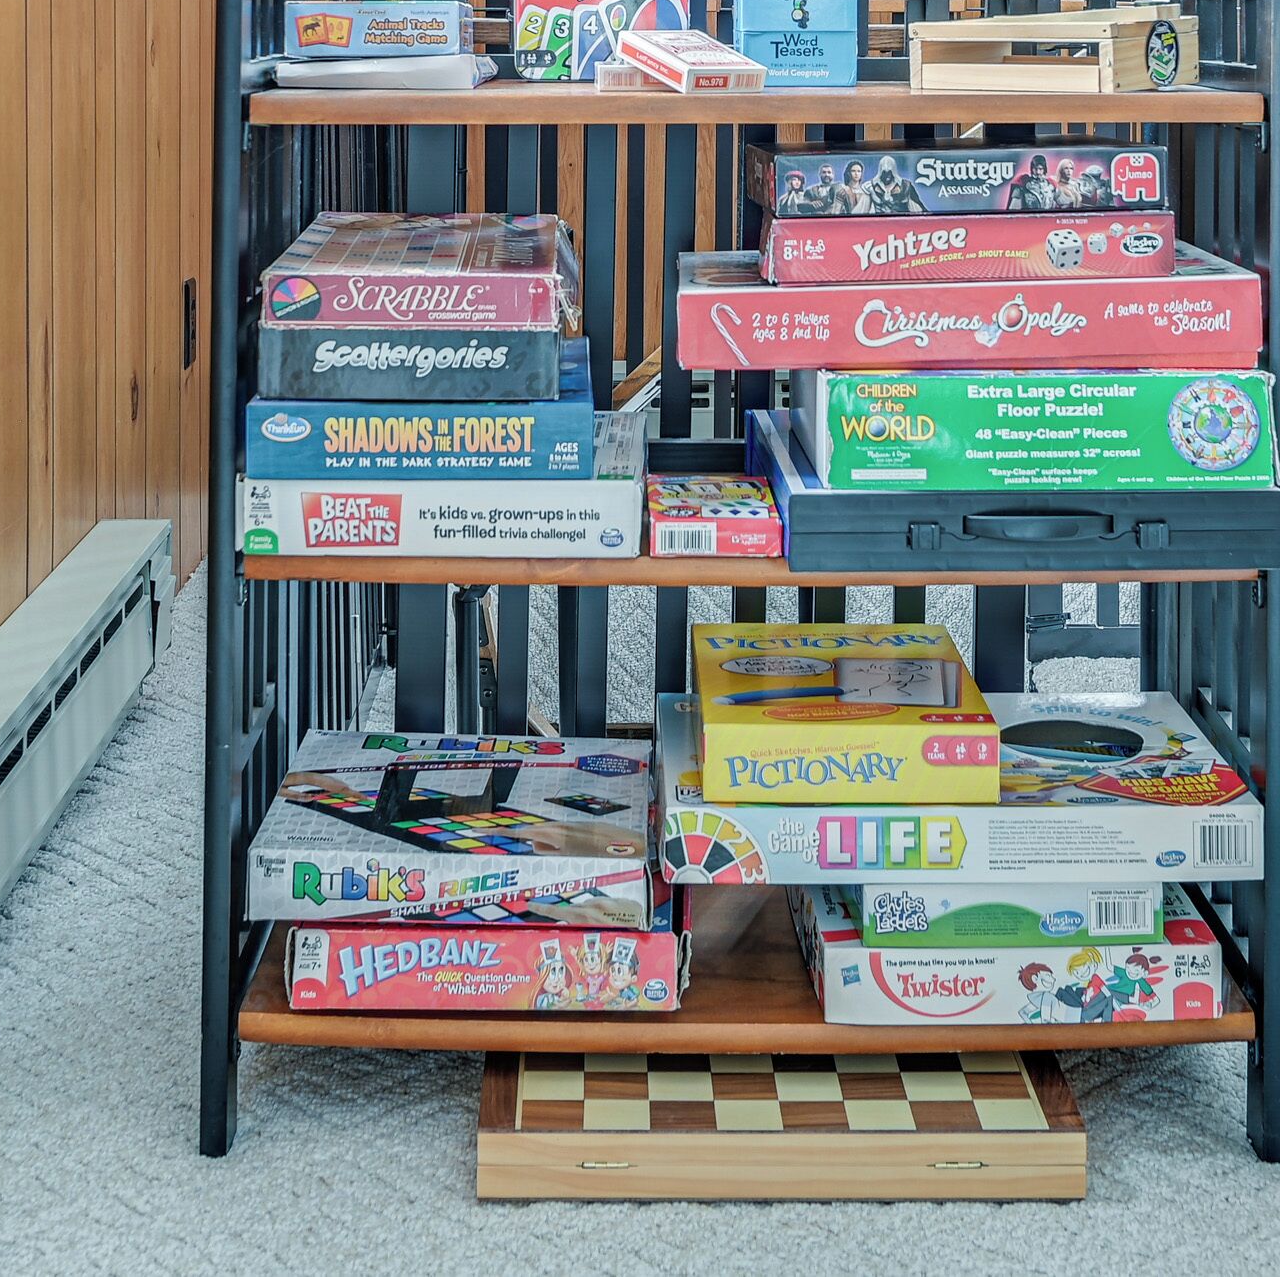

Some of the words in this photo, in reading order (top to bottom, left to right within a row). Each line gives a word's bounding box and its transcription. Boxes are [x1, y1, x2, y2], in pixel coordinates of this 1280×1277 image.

[369, 17, 408, 31] Animal
[410, 18, 446, 31] Tracks
[525, 16, 542, 35] 2
[554, 18, 570, 38] 3
[583, 14, 599, 35] 4
[364, 30, 415, 47] Matching
[416, 33, 448, 45] Game
[783, 33, 818, 46] Word
[770, 41, 824, 58] Teasers
[768, 68, 789, 77] World
[790, 69, 830, 78] Geography
[916, 158, 1014, 186] Stratego
[1118, 165, 1153, 182] Jumbo
[783, 247, 799, 260] 8+
[852, 226, 968, 271] Yahtzee
[910, 256, 938, 267] SHAKE,
[939, 252, 964, 263] SCORE,
[978, 250, 1005, 259] SHOUT
[1005, 249, 1030, 258] GAME!
[333, 277, 483, 320] SCRABBLE
[428, 310, 472, 319] crossword
[472, 312, 496, 321] game
[1104, 302, 1115, 319] A
[1118, 305, 1144, 316] game
[1148, 301, 1159, 315] to
[1163, 298, 1213, 314] celebrate
[752, 314, 761, 326] 2
[765, 312, 778, 325] to
[782, 314, 789, 325] 6
[794, 311, 830, 326] Players
[854, 298, 984, 348] Christmas
[1154, 315, 1168, 327] the
[1171, 310, 1231, 335] Season!
[752, 328, 775, 343] Ages
[780, 328, 788, 340] 8
[792, 327, 811, 339] And
[816, 327, 830, 341] Up
[313, 339, 508, 377] Scattergories
[856, 383, 917, 398] CHILDREN
[967, 385, 1013, 399] Extra
[1017, 385, 1065, 403] Large
[1070, 384, 1137, 398] Circular
[870, 400, 882, 412] of
[885, 400, 904, 412] the
[997, 403, 1041, 417] Floor
[1045, 403, 1103, 417] Puzzle!
[324, 416, 432, 453] SHADOWS
[437, 418, 448, 434] IN
[453, 416, 535, 453] FOREST
[840, 415, 935, 442] WORLD
[975, 429, 992, 440] 48
[1083, 428, 1128, 439] Pieces
[434, 435, 452, 452] THE
[555, 442, 579, 453] AGES
[325, 457, 355, 468] PLAY
[359, 457, 371, 467] IN
[375, 457, 398, 467] THE
[402, 457, 432, 467] DARK
[437, 456, 494, 467] STRATEGY
[499, 457, 532, 467] GAME
[562, 454, 579, 462] Adult
[965, 449, 994, 459] Giant
[995, 450, 1028, 460] puzzle
[1030, 450, 1081, 458] measures
[1102, 448, 1141, 458] across!
[1031, 476, 1061, 485] looking
[321, 494, 371, 521] BEAT
[368, 505, 390, 519] THE
[439, 505, 468, 520] kids
[471, 512, 486, 520] vs.
[489, 508, 563, 523] grown-ups
[566, 509, 577, 520] in
[578, 509, 600, 520] this
[308, 517, 397, 545] PARENTS
[433, 525, 496, 538] fun-filled
[499, 527, 528, 538] trivia
[530, 527, 586, 542] challenge!
[704, 634, 943, 651] PICTIONARY
[1031, 704, 1082, 715] Spin
[1089, 708, 1112, 717] to
[750, 749, 772, 758] Quick
[774, 747, 813, 756] Sketches,
[724, 752, 903, 789] PICTIONARY
[1118, 778, 1165, 787] KIDS
[1169, 774, 1221, 785] HAVE
[1132, 782, 1219, 794] SPOKEN!
[780, 817, 804, 835] the
[768, 829, 820, 854] Game
[826, 821, 952, 864] LIFE
[802, 847, 820, 865] of
[438, 869, 520, 899] RACE
[390, 903, 432, 918] SHAKE
[434, 901, 448, 912] IT
[464, 893, 504, 907] SLIDE
[506, 891, 519, 902] IT
[534, 883, 575, 898] SOLVE
[578, 877, 597, 890] IT!
[874, 891, 925, 914] Chutes
[875, 912, 928, 934] Ladders
[1046, 913, 1081, 925] Hasbro
[339, 937, 501, 998] HEDBANZ
[932, 958, 944, 966] ties
[945, 960, 957, 968] you
[958, 958, 967, 967] up
[975, 957, 995, 965] knots!
[417, 972, 433, 982] The
[434, 971, 462, 982] QUICK
[464, 973, 504, 983] Question
[505, 974, 531, 982] Game
[1175, 968, 1186, 978] 6+
[433, 983, 442, 992] of
[478, 984, 496, 994] Am
[897, 972, 985, 998] Twister
[300, 991, 316, 999] Kids
[1186, 1000, 1201, 1008] Kids
